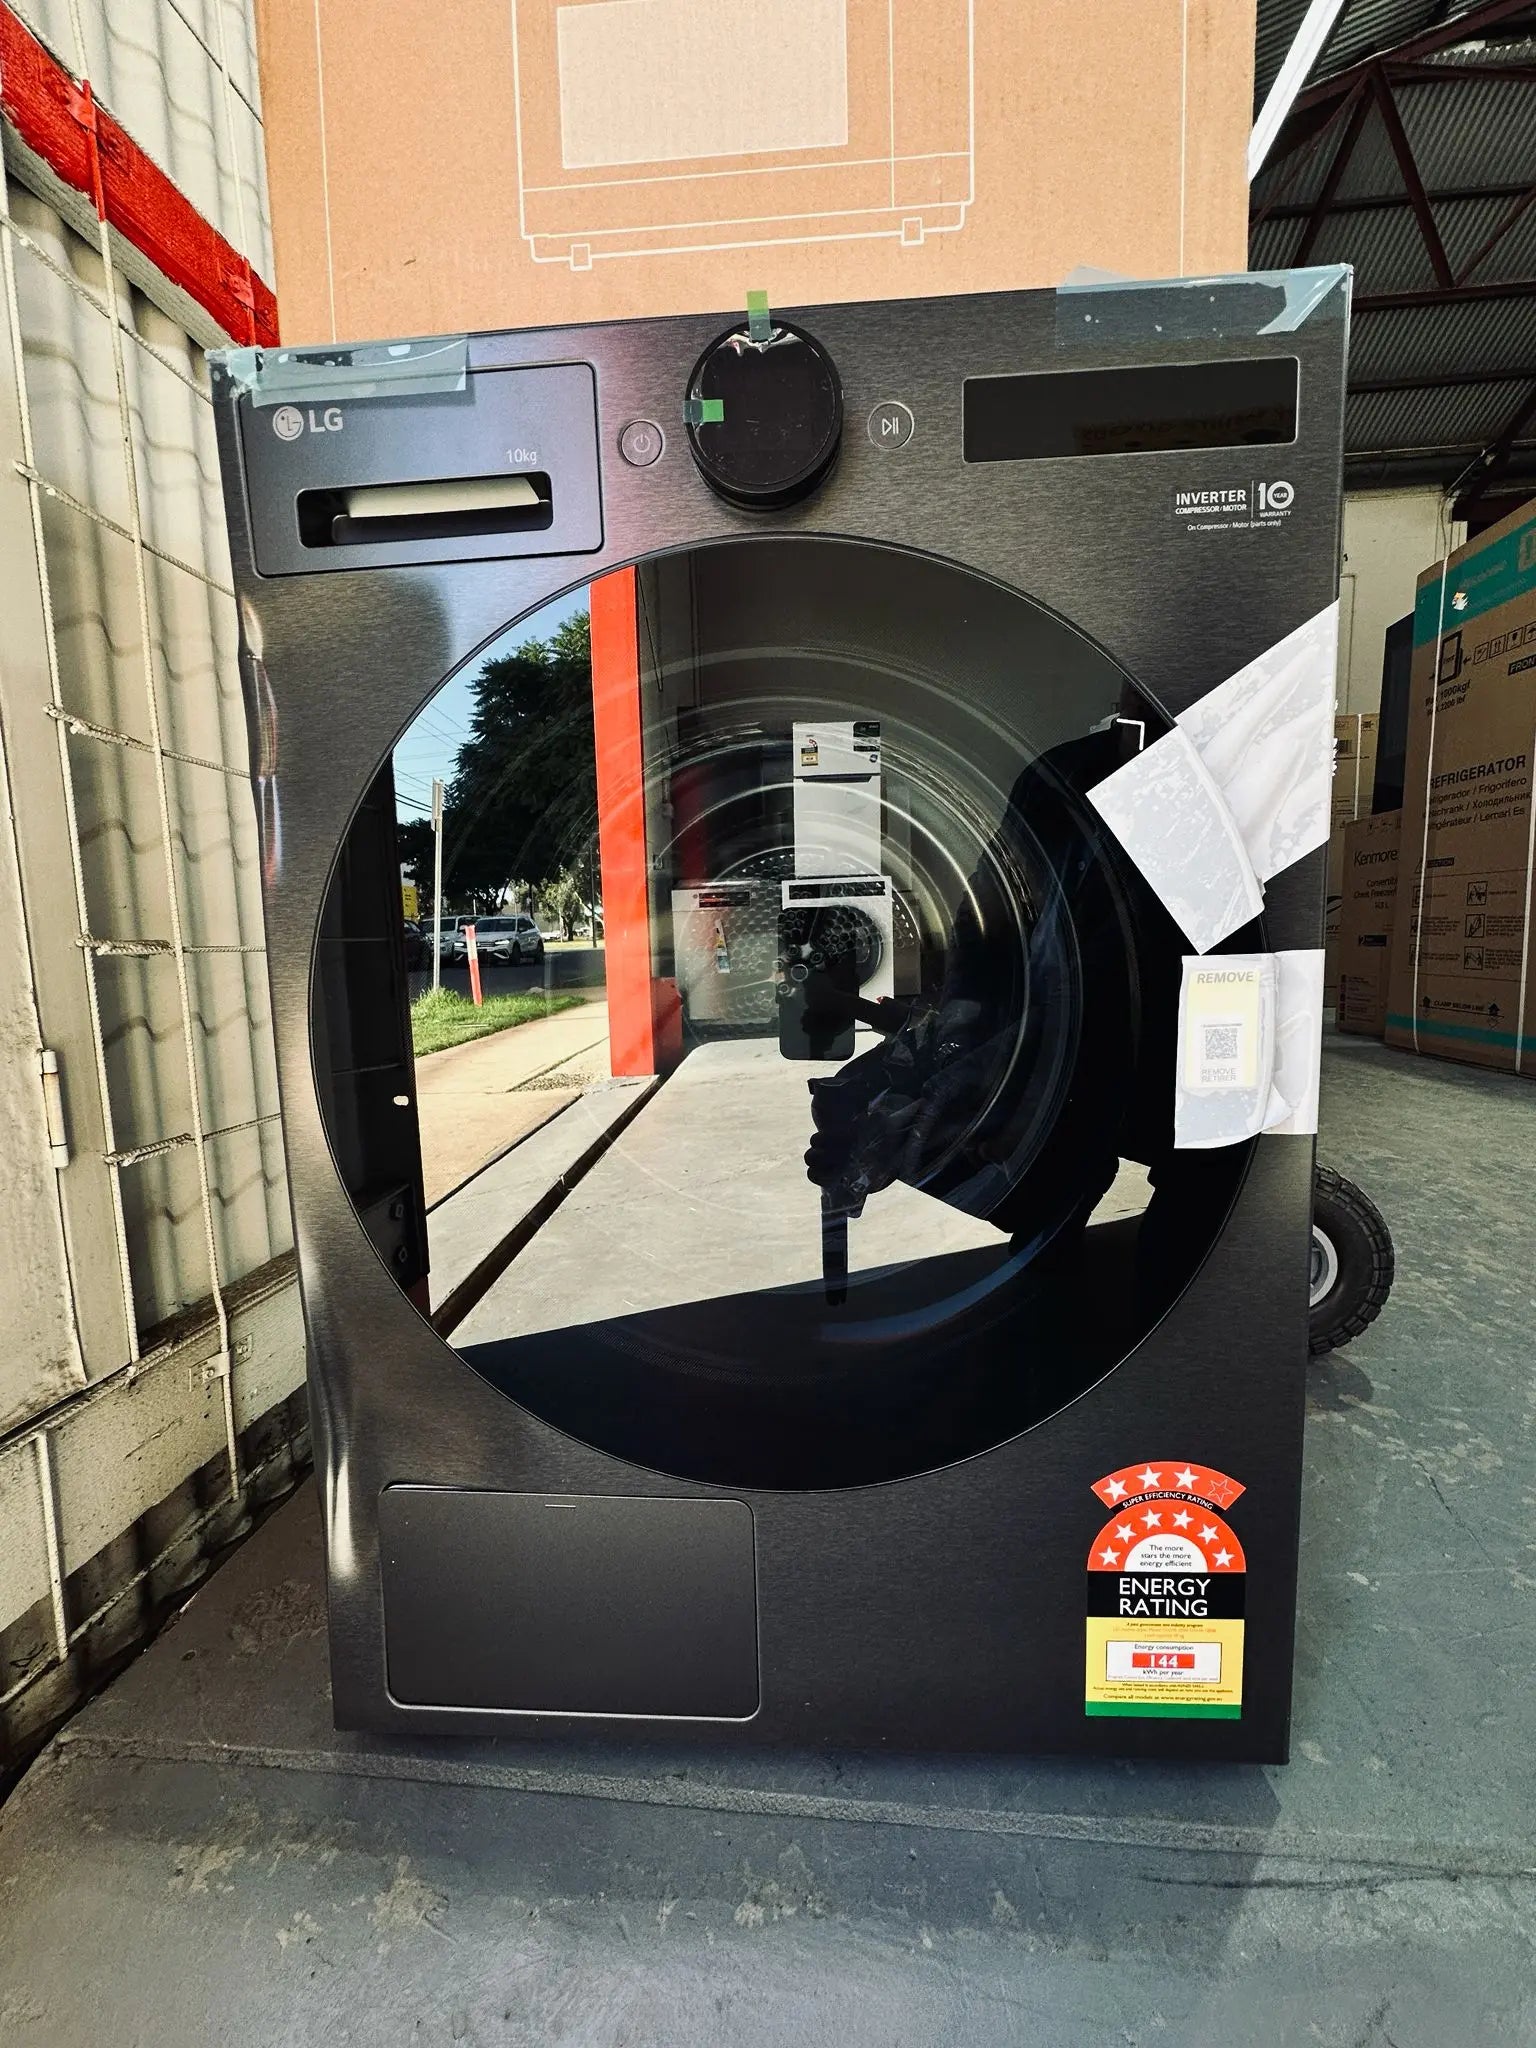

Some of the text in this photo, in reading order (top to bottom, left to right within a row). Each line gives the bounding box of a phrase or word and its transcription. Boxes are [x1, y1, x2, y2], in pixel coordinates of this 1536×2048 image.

[308, 407, 344, 433] LG
[505, 448, 537, 464] 10kg
[1176, 489, 1247, 506] INVERTER
[1259, 510, 1292, 518] WARRANTY
[1197, 523, 1229, 531] Compressor
[1232, 521, 1250, 529] Motor
[1510, 655, 1536, 673] FRON
[1513, 806, 1525, 816] Es
[1353, 848, 1398, 868] Kenmore
[1197, 971, 1254, 984] REMOVE
[1201, 1067, 1237, 1075] REMOVE
[1122, 1491, 1214, 1510] SUPER EFFICIENCY RATING
[1139, 1560, 1163, 1568] energy
[1119, 1577, 1212, 1596] ENERGY
[1119, 1597, 1208, 1617] RATING
[1134, 1643, 1194, 1652] Energy consumption
[1149, 1654, 1179, 1668] 144
